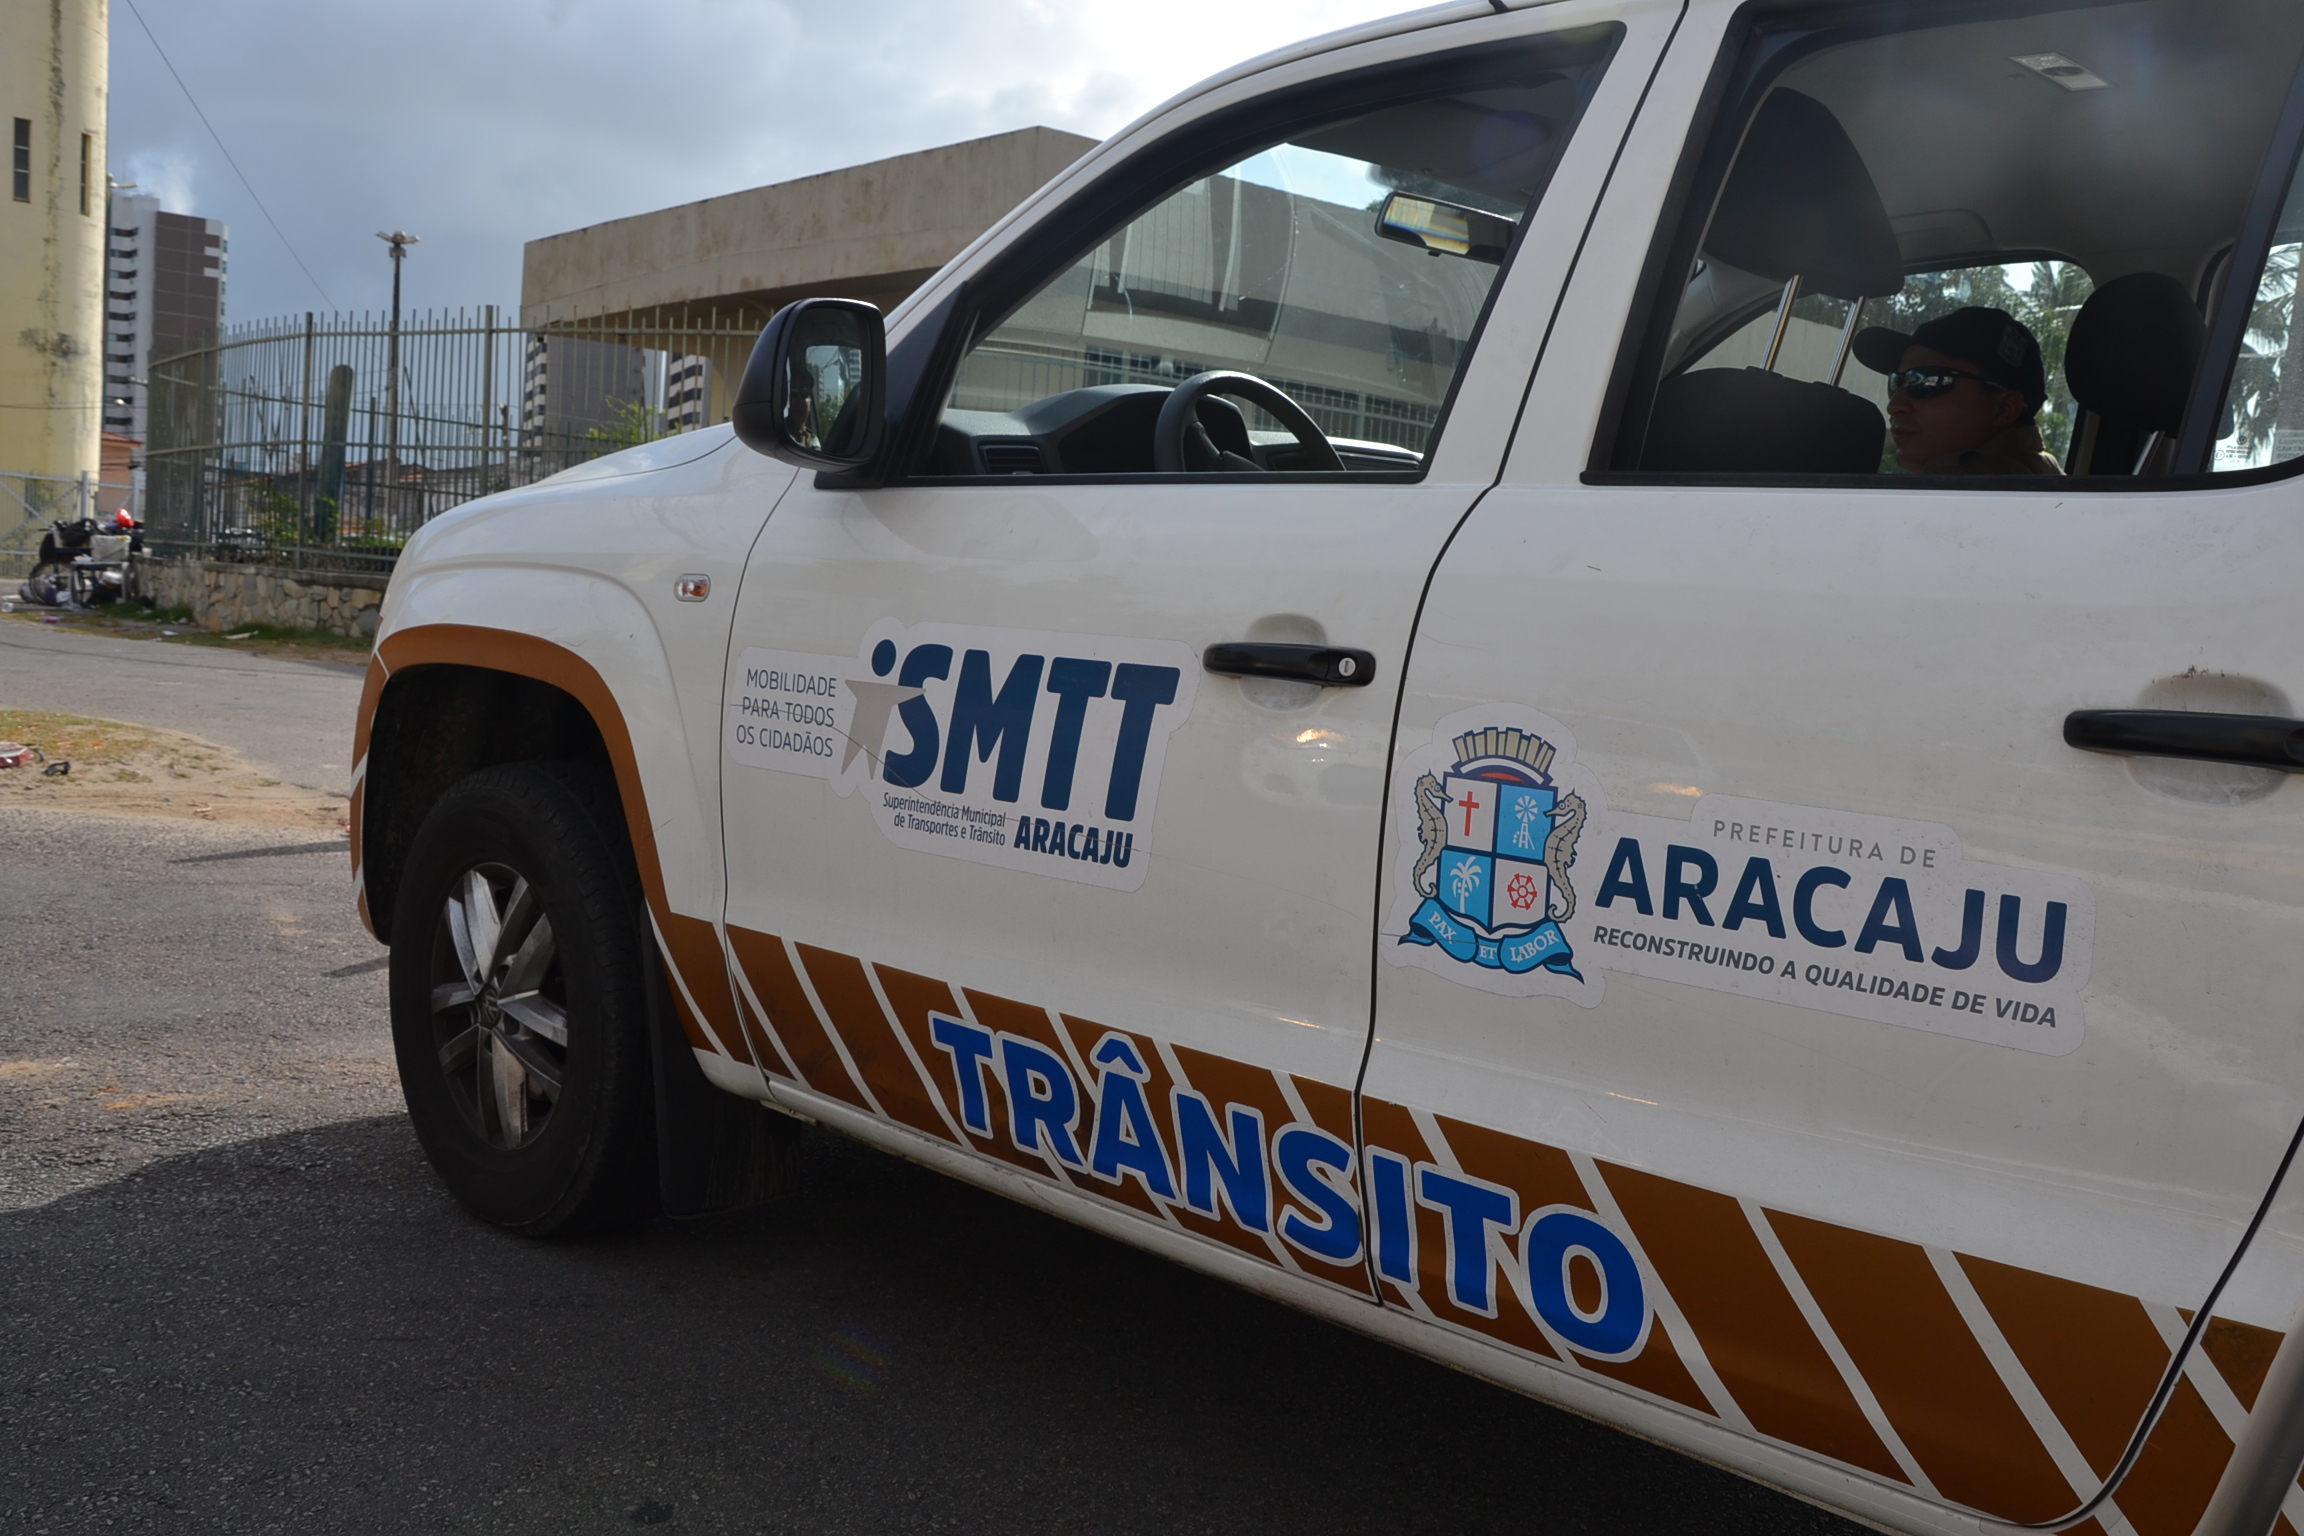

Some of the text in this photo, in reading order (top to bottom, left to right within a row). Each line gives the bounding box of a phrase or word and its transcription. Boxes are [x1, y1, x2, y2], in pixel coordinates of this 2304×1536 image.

[746, 667, 837, 698] MOBILIDADE
[741, 696, 835, 728] PARA TODOS
[736, 724, 833, 758] OS CIDADÃOS
[882, 792, 1007, 828] Superintendência Municipal
[893, 812, 1006, 847] de Transportes e Trânsito
[1013, 815, 1134, 869] ARACAJU
[1713, 820, 1936, 869] PREFEITURA DE
[1594, 837, 2068, 984] ARACAJU
[1428, 911, 1560, 963] PAX ET LABOR
[1593, 925, 2058, 1029] RECONSTRUINDO A QUALIDADE DE VIDA
[928, 1011, 1653, 1363] TRÂNSITO
